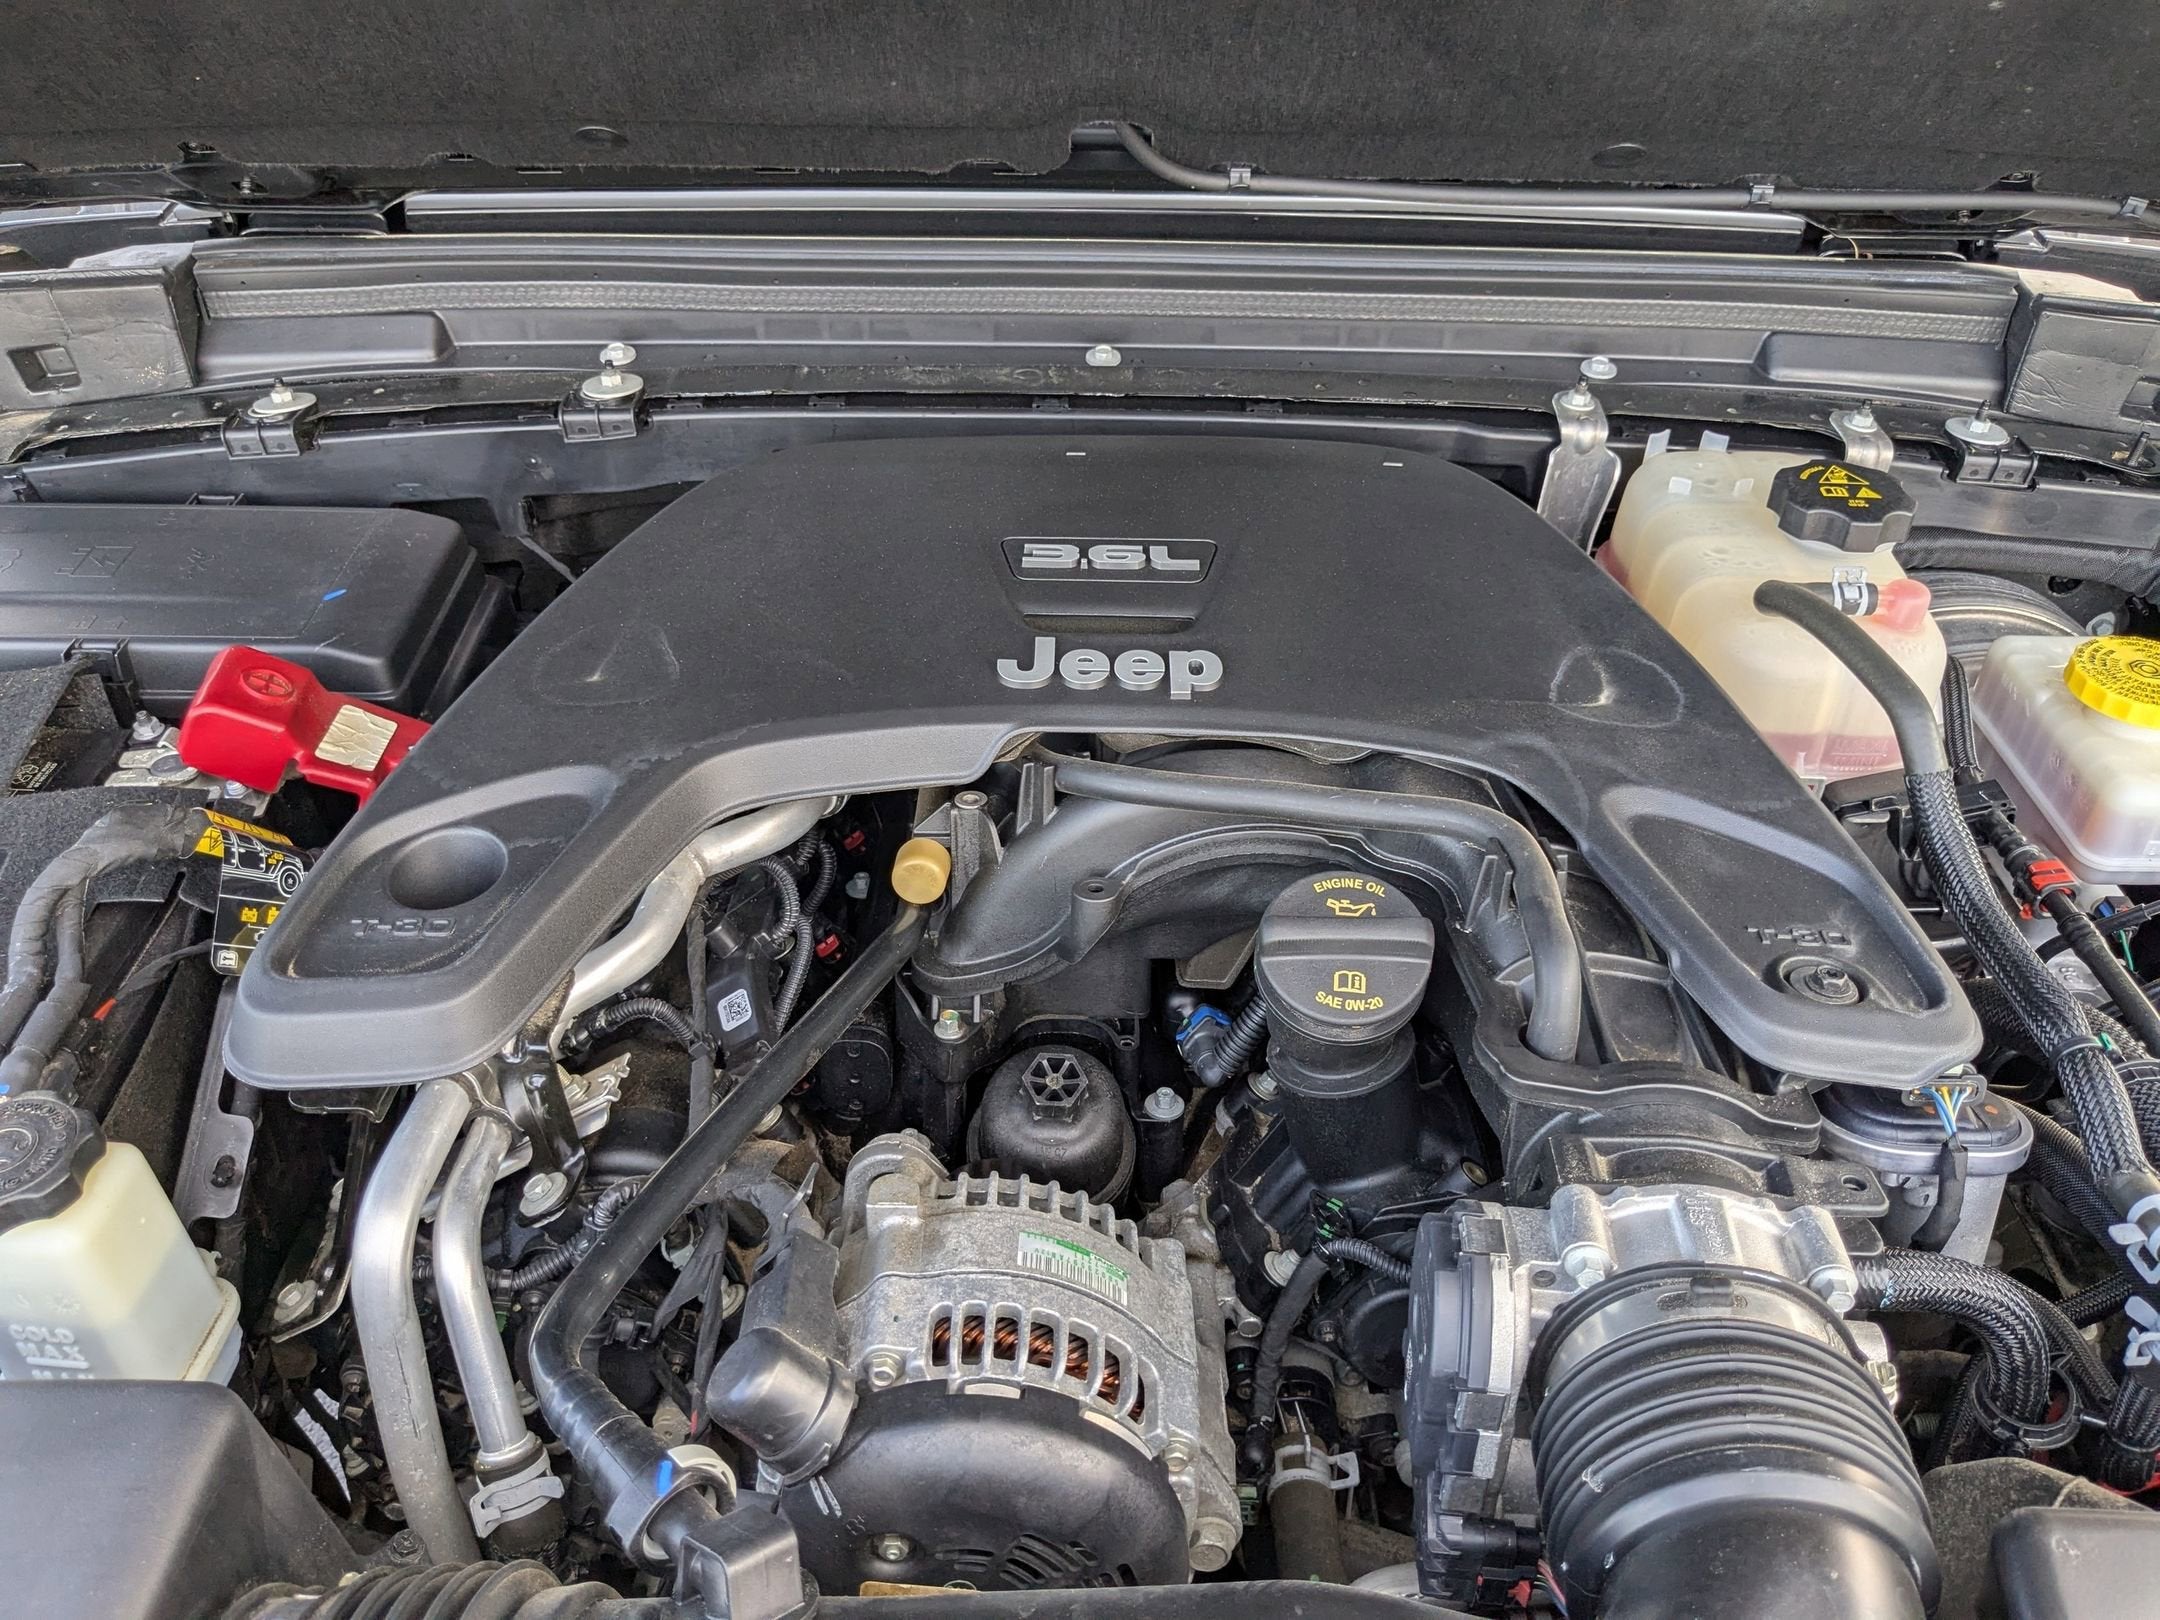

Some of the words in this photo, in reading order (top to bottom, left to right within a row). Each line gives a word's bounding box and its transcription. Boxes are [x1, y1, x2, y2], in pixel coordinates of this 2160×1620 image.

[1021, 543, 1200, 571] 3.6L
[997, 637, 1223, 700] Jeep
[1313, 878, 1363, 893] ENGINE
[1365, 882, 1387, 898] OIL
[1315, 991, 1342, 1009] SAE
[1344, 996, 1384, 1011] 0W-20
[8, 1324, 75, 1345] COLD
[16, 1341, 85, 1361] MAX
